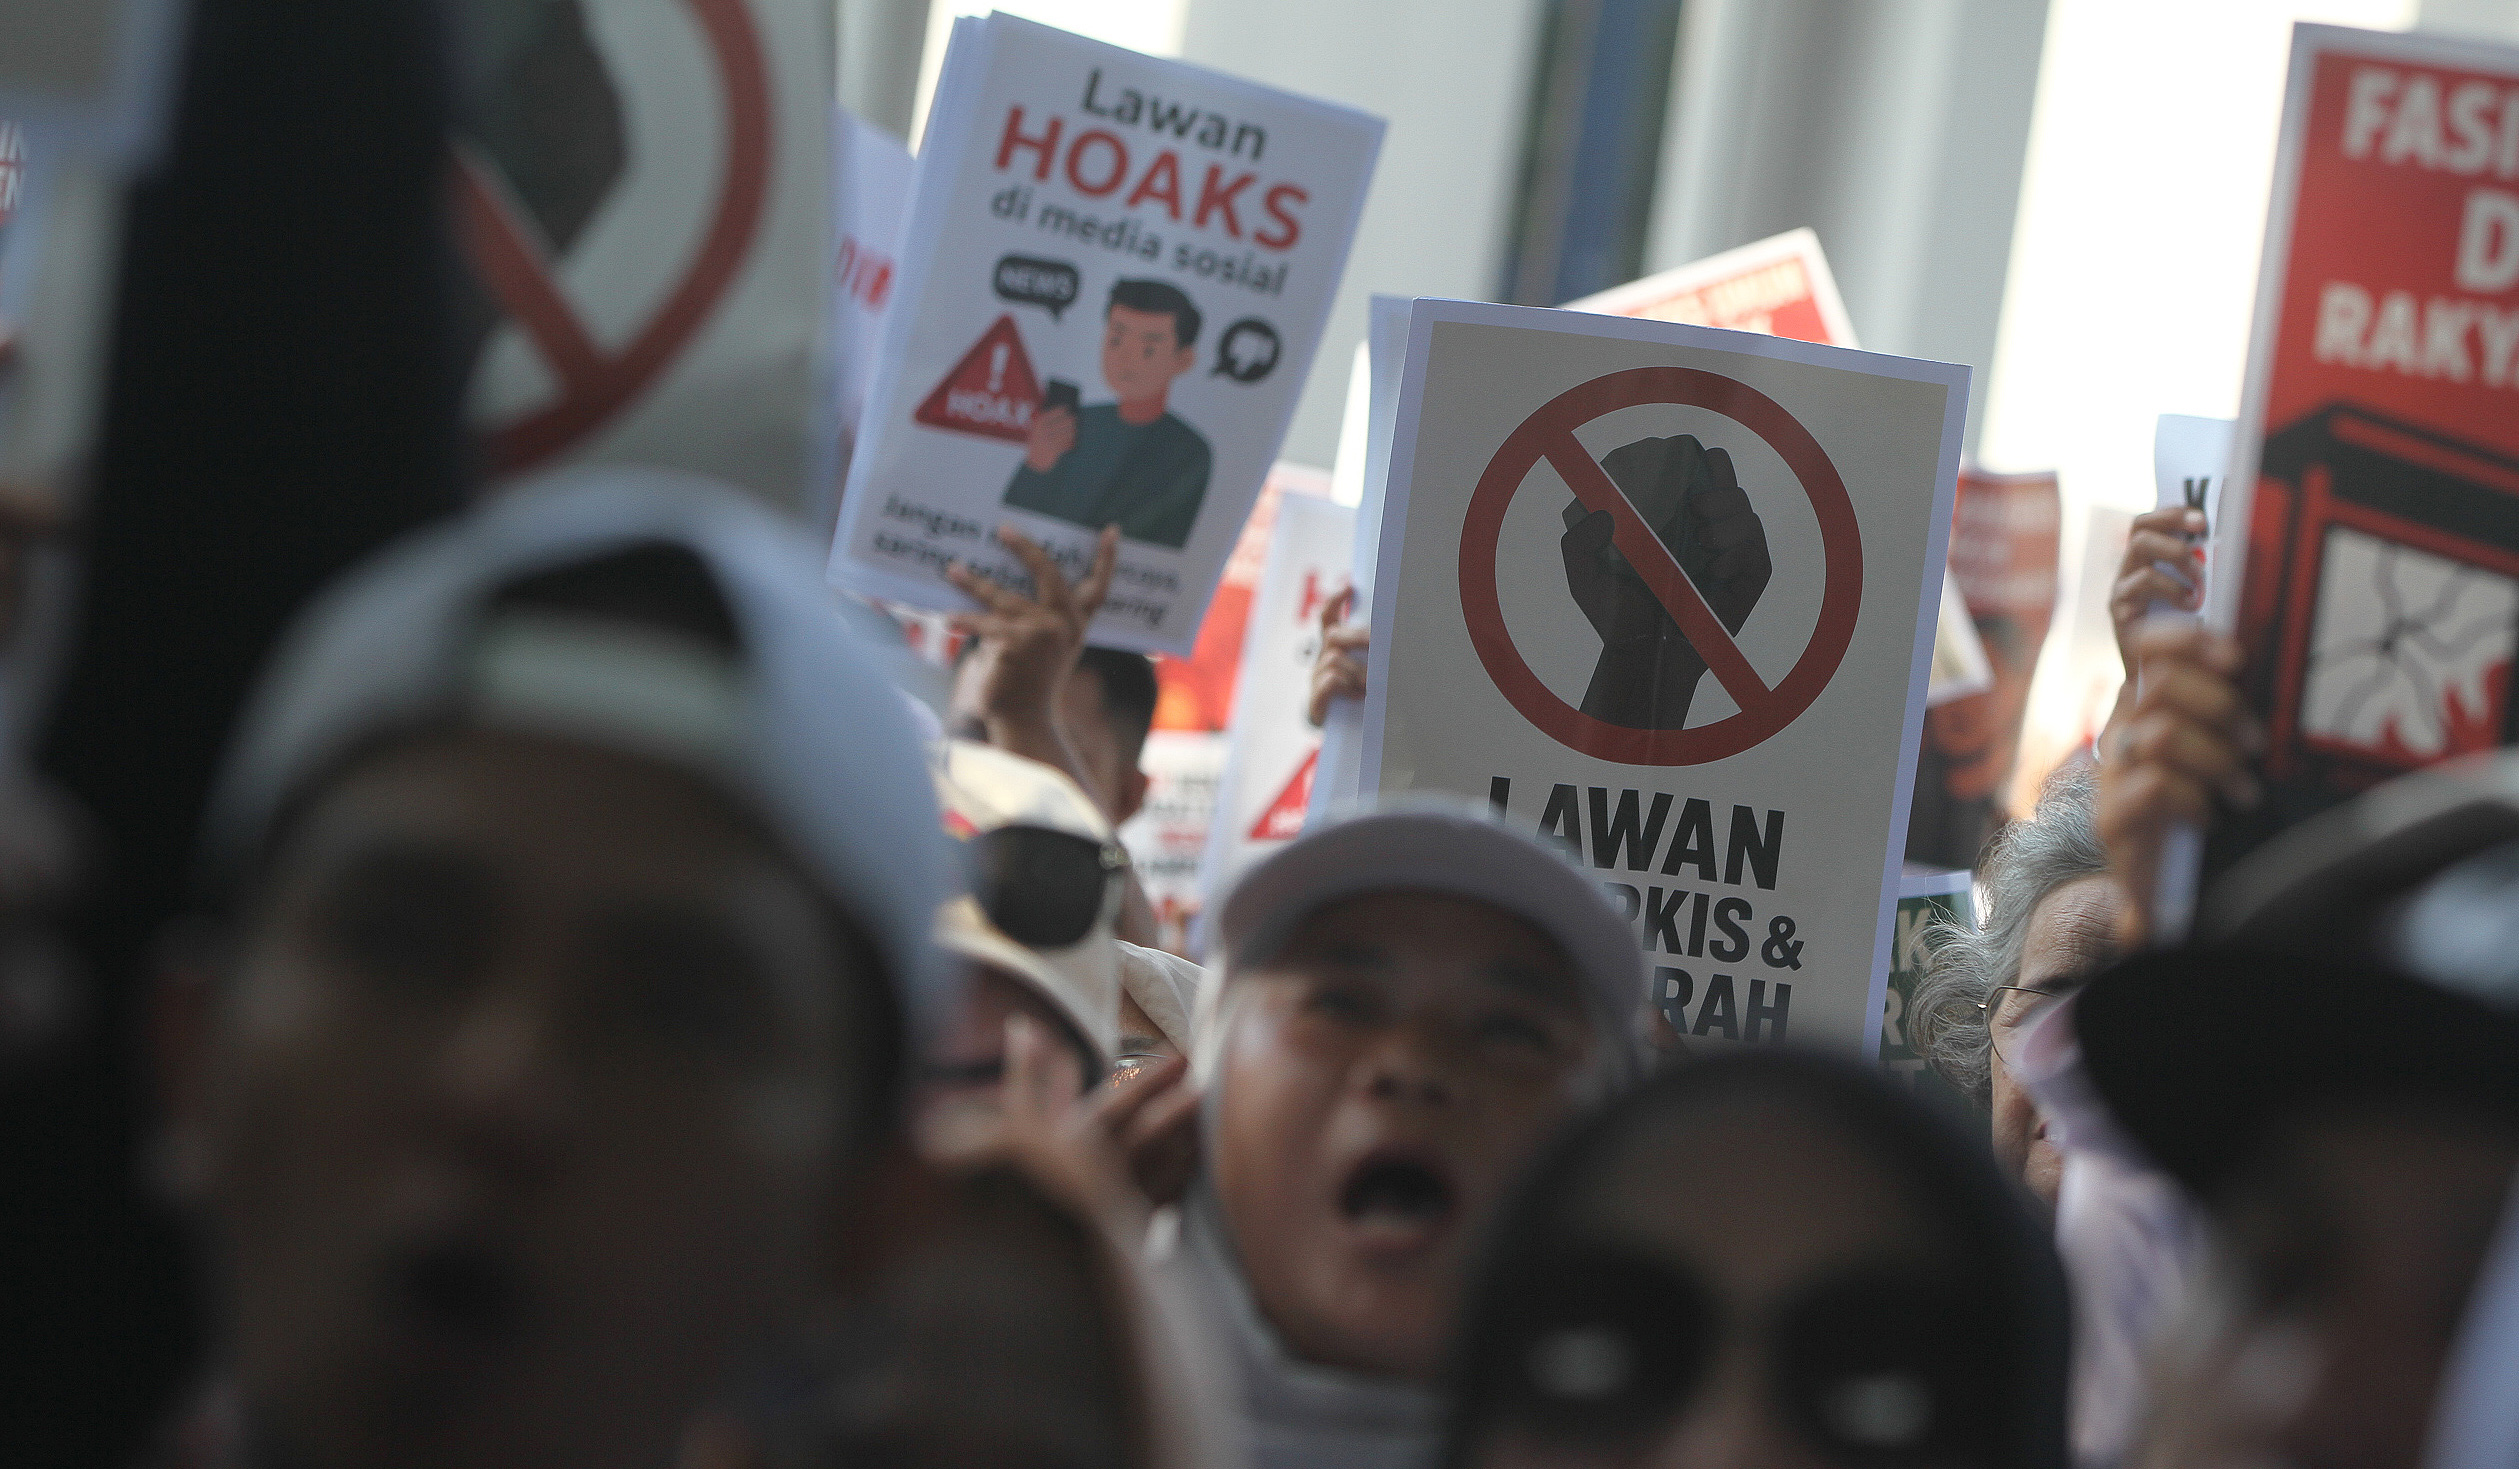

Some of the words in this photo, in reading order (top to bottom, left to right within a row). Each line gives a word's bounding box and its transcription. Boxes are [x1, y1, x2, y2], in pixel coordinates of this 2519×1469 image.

[1082, 67, 1267, 161] Lawan
[2343, 66, 2519, 180] FASI
[995, 105, 1309, 250] HOAKS
[991, 184, 1033, 221] di
[1038, 203, 1164, 261] media
[1171, 243, 1290, 297] sosial
[2455, 187, 2519, 292] D
[2312, 280, 2519, 388] RAKY
[882, 494, 982, 538] Jangan
[1760, 914, 1805, 972] &
[1652, 965, 1792, 1043] RAH
